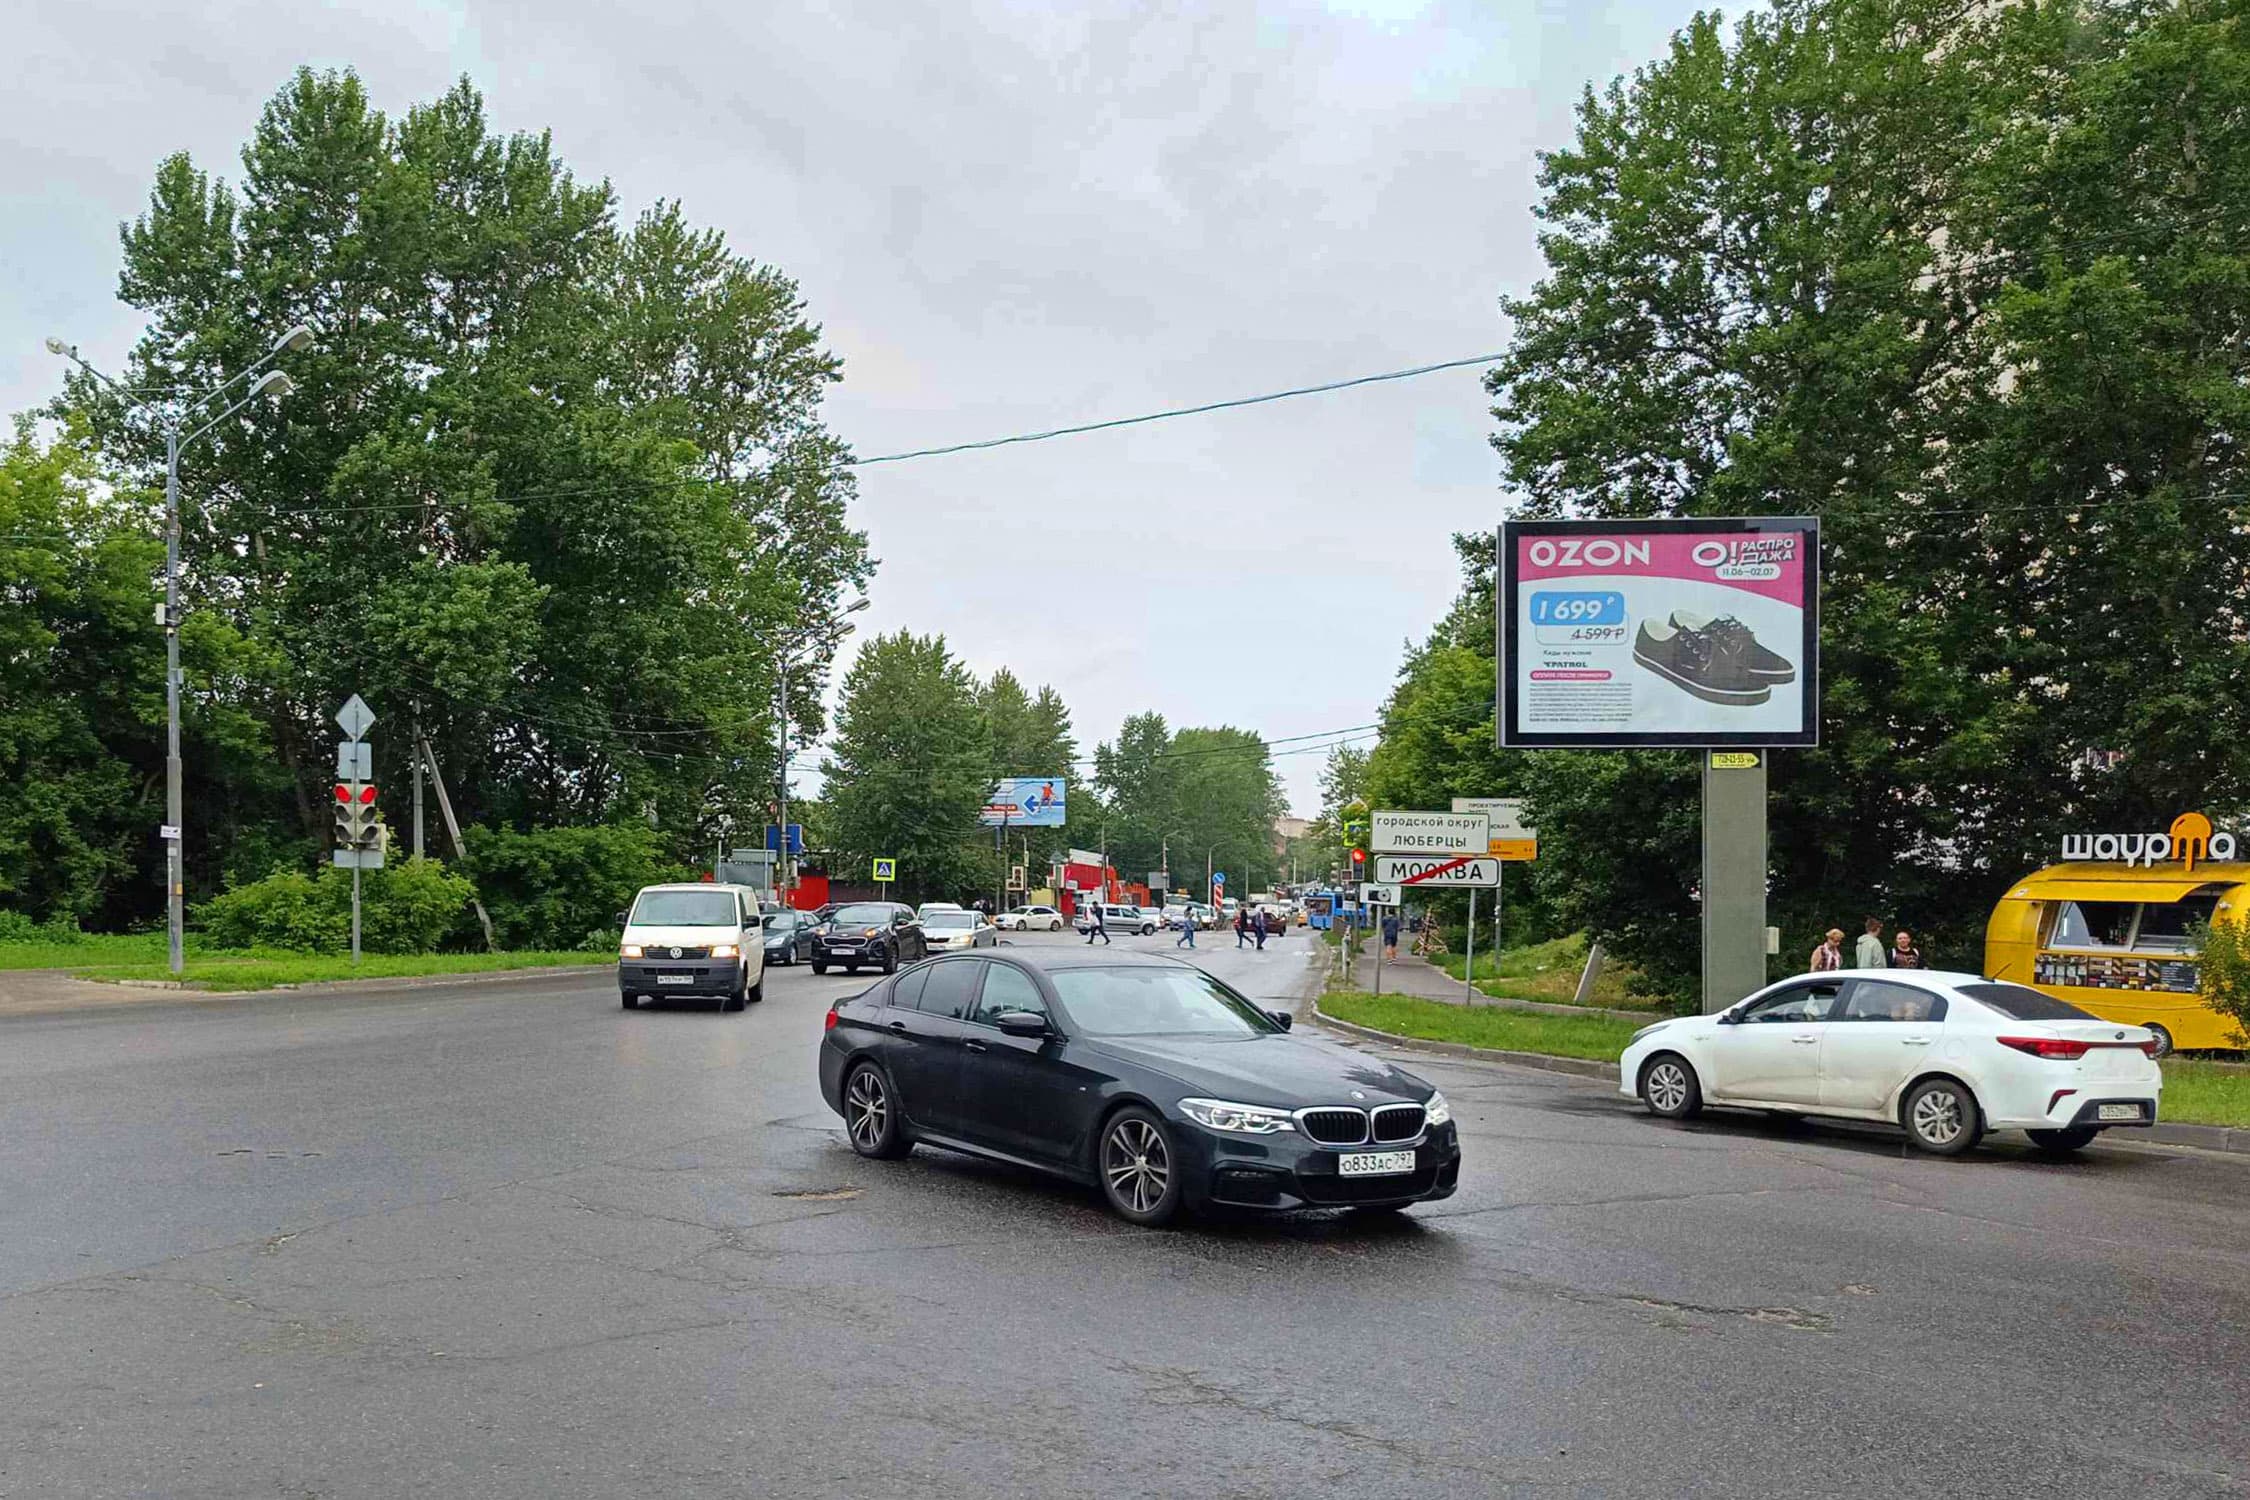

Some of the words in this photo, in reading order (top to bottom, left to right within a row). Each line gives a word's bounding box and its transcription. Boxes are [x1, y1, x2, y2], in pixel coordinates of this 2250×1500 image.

[1740, 539, 1795, 552] РАСПРО
[1529, 540, 1650, 567] OZON
[1554, 600, 1602, 619] 699
[1377, 817, 1443, 829] городской
[1447, 819, 1484, 830] округ
[1393, 835, 1466, 848] ЛЮБЕРЦЫ
[1391, 863, 1483, 880] МОСКВА
